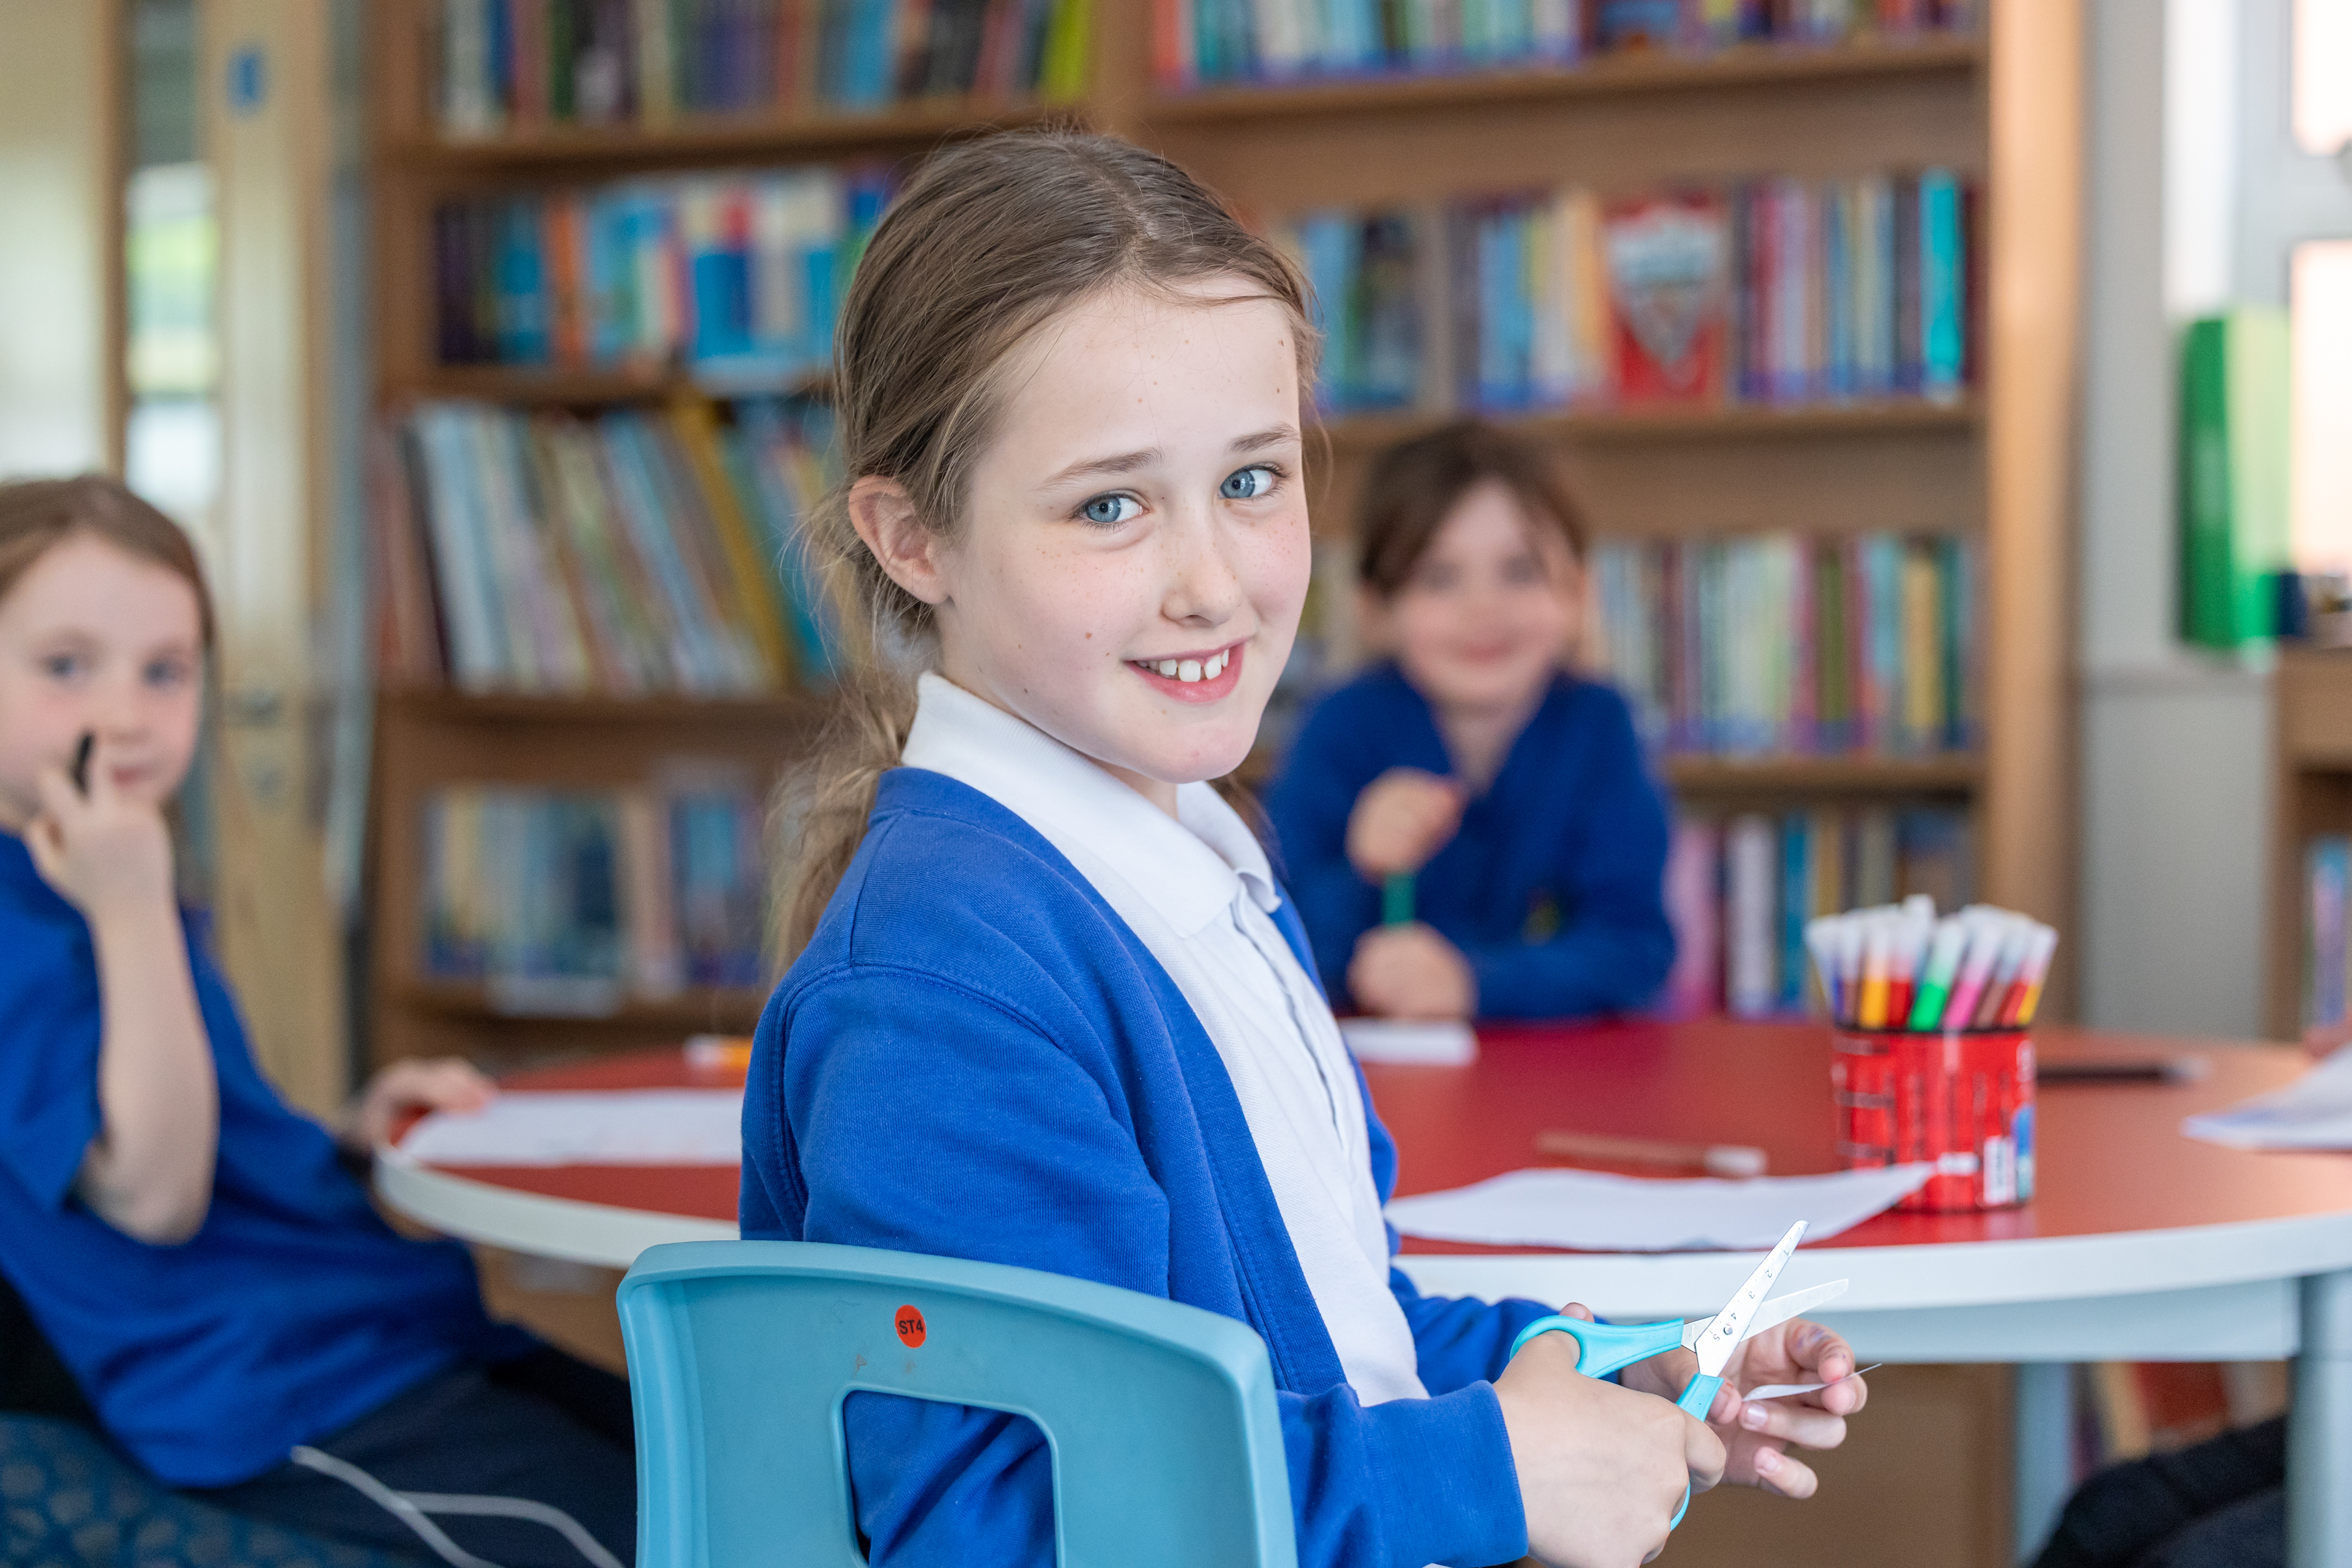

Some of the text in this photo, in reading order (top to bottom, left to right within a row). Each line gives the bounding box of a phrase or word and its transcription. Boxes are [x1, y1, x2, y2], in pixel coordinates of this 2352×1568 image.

[1765, 1270, 1772, 1278] 2
[898, 1319, 924, 1335] ST4
[1713, 1333, 1720, 1342] 5
